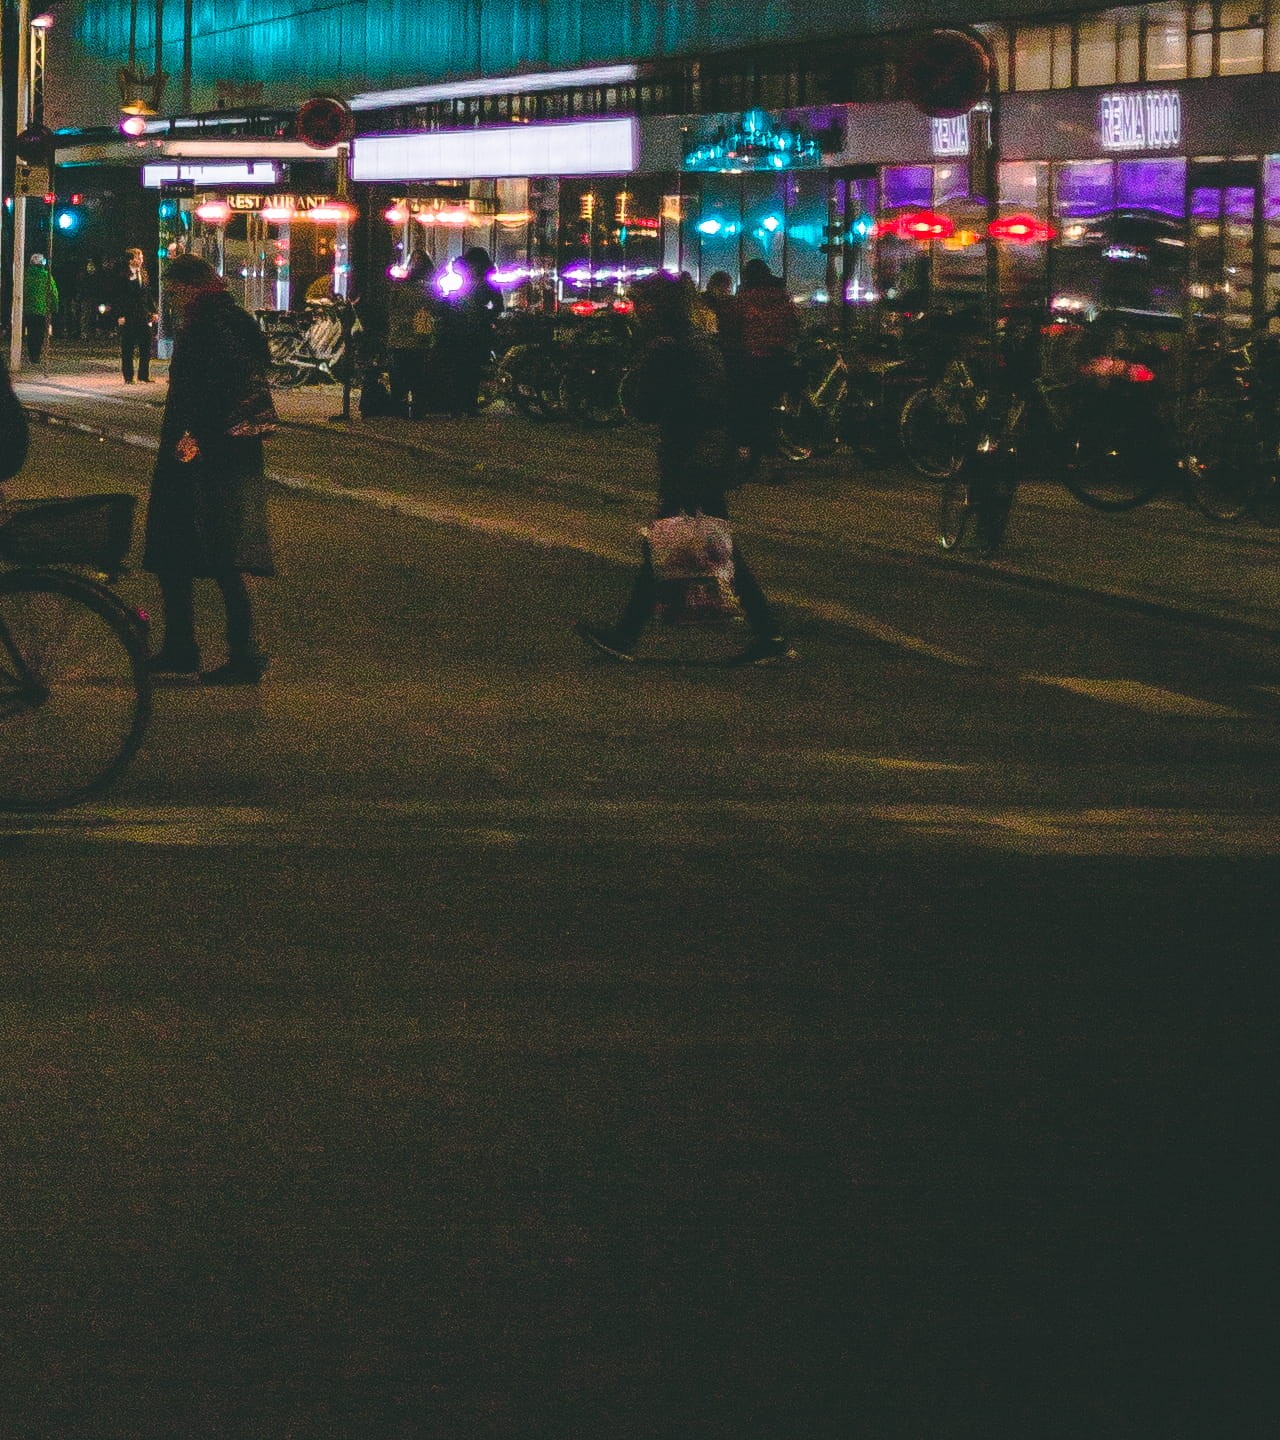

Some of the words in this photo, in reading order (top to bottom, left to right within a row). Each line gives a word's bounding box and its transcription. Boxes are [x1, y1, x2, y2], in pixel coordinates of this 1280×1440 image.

[1101, 94, 1144, 151] REMA
[1145, 89, 1181, 149] 1000
[226, 194, 328, 210] RESTAURANT
